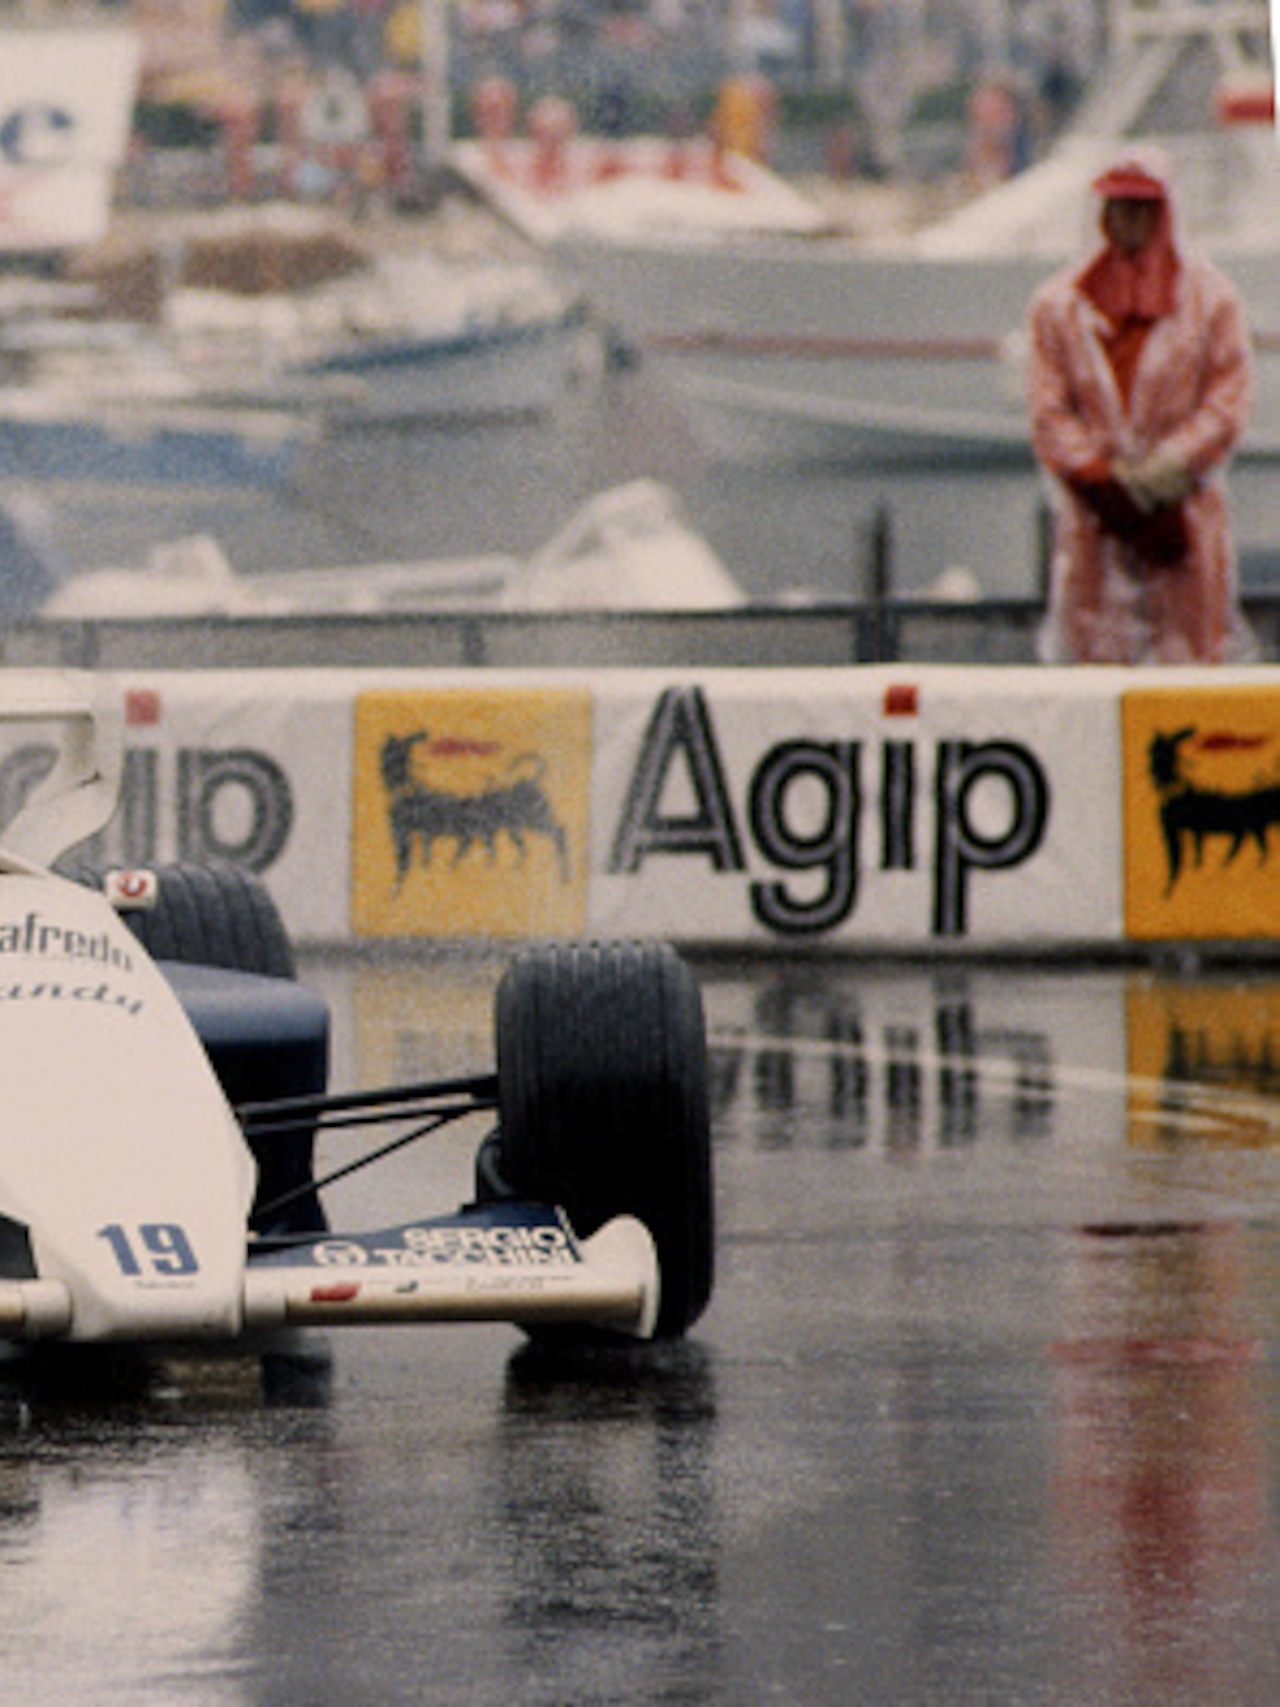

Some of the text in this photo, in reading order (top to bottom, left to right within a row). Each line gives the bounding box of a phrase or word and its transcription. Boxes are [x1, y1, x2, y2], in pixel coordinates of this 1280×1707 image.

[608, 685, 1050, 937] Agip
[96, 1223, 200, 1276] 19
[403, 1227, 567, 1250] SERGIO
